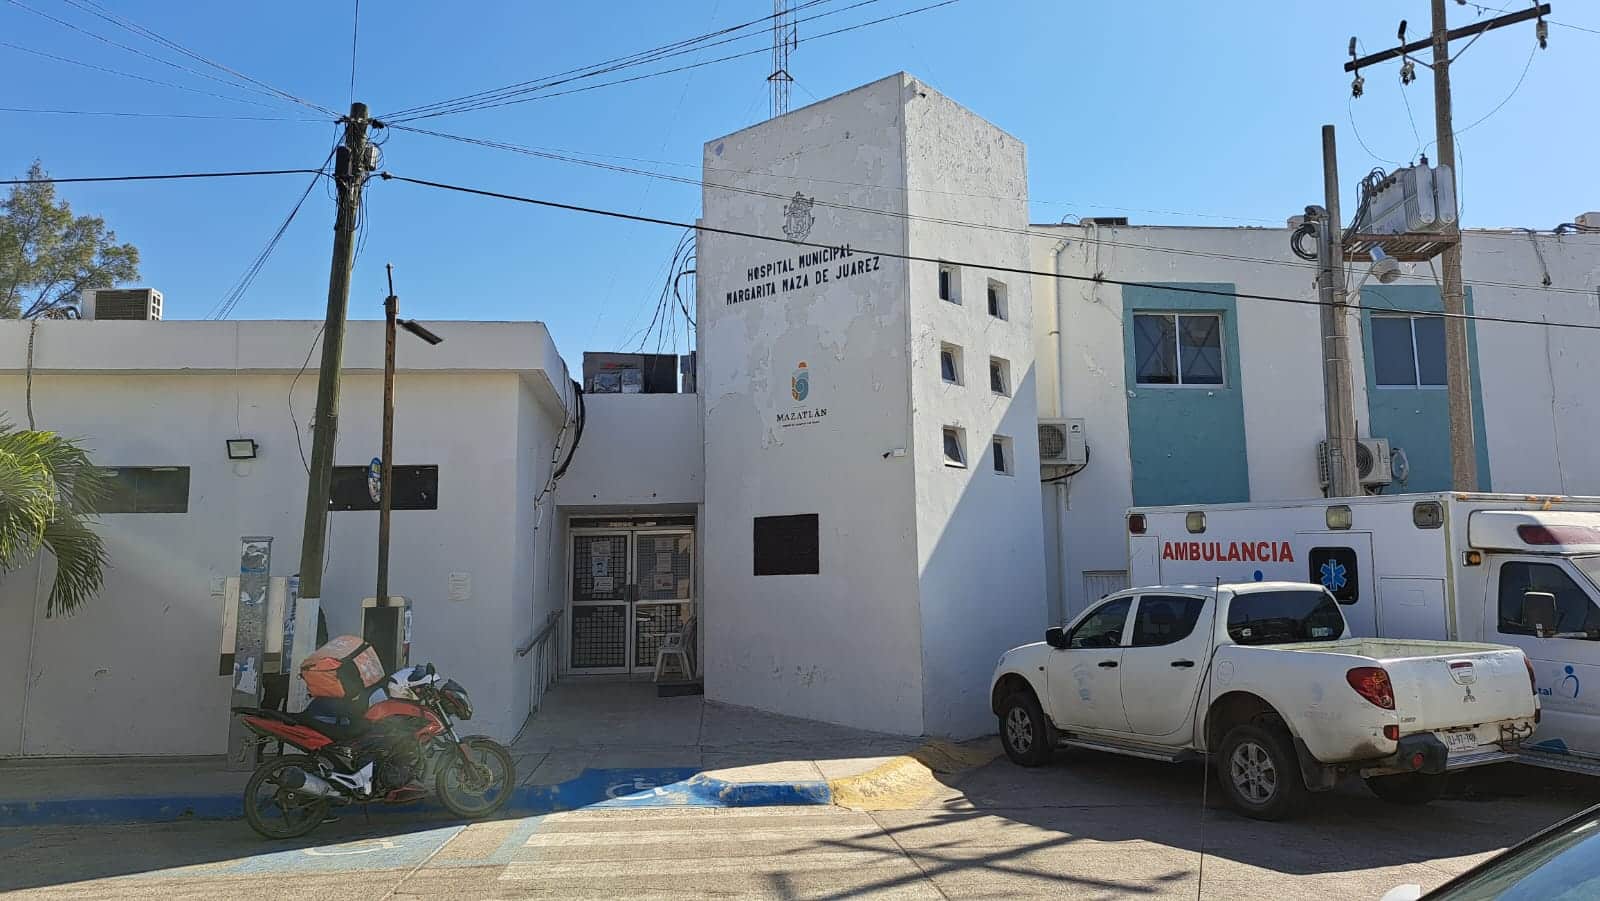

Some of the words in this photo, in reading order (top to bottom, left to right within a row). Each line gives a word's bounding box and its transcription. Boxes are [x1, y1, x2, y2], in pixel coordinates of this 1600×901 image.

[747, 258, 795, 282] HOSPITAL
[798, 244, 853, 269] MUNICIPAL
[726, 281, 776, 305] MARGARITA
[782, 273, 809, 293] MAZA
[815, 268, 829, 285] DE
[835, 256, 880, 280] JUAREZ
[1161, 541, 1295, 562] AMBULANCIA
[1537, 687, 1552, 696] tal
